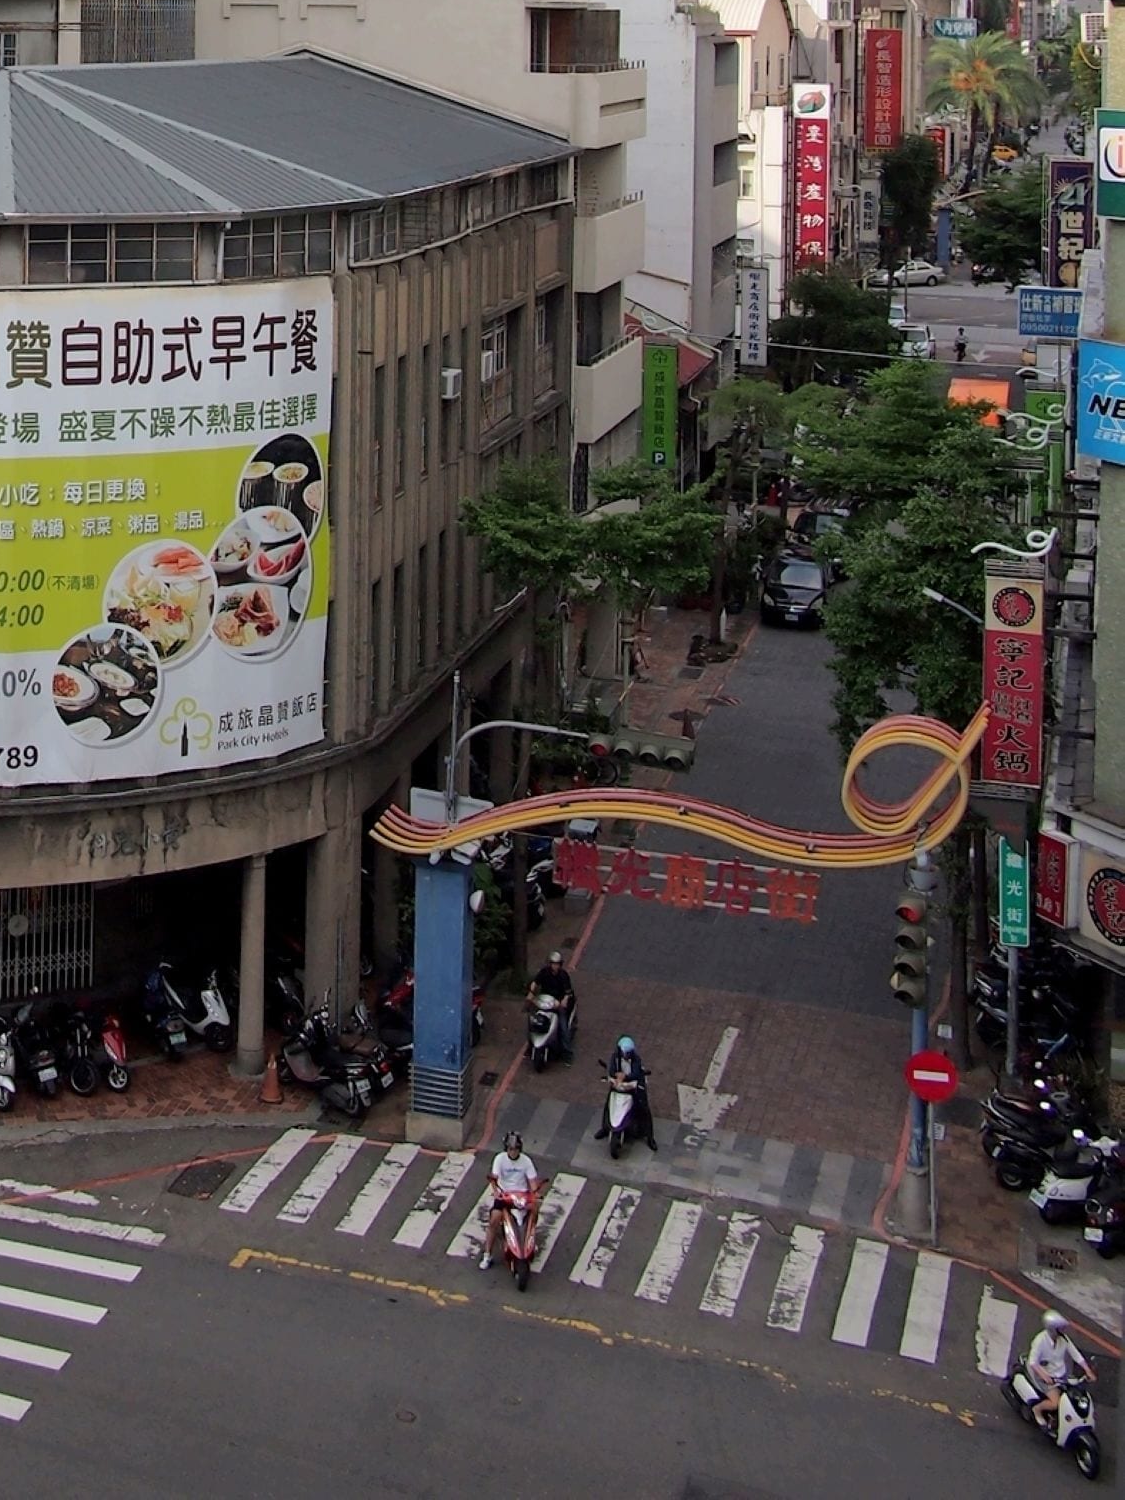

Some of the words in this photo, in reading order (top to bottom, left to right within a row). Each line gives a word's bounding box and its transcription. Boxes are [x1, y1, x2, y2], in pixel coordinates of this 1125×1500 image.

[217, 739, 239, 751] Park
[240, 734, 261, 748] City
[262, 727, 290, 743] Hotels
